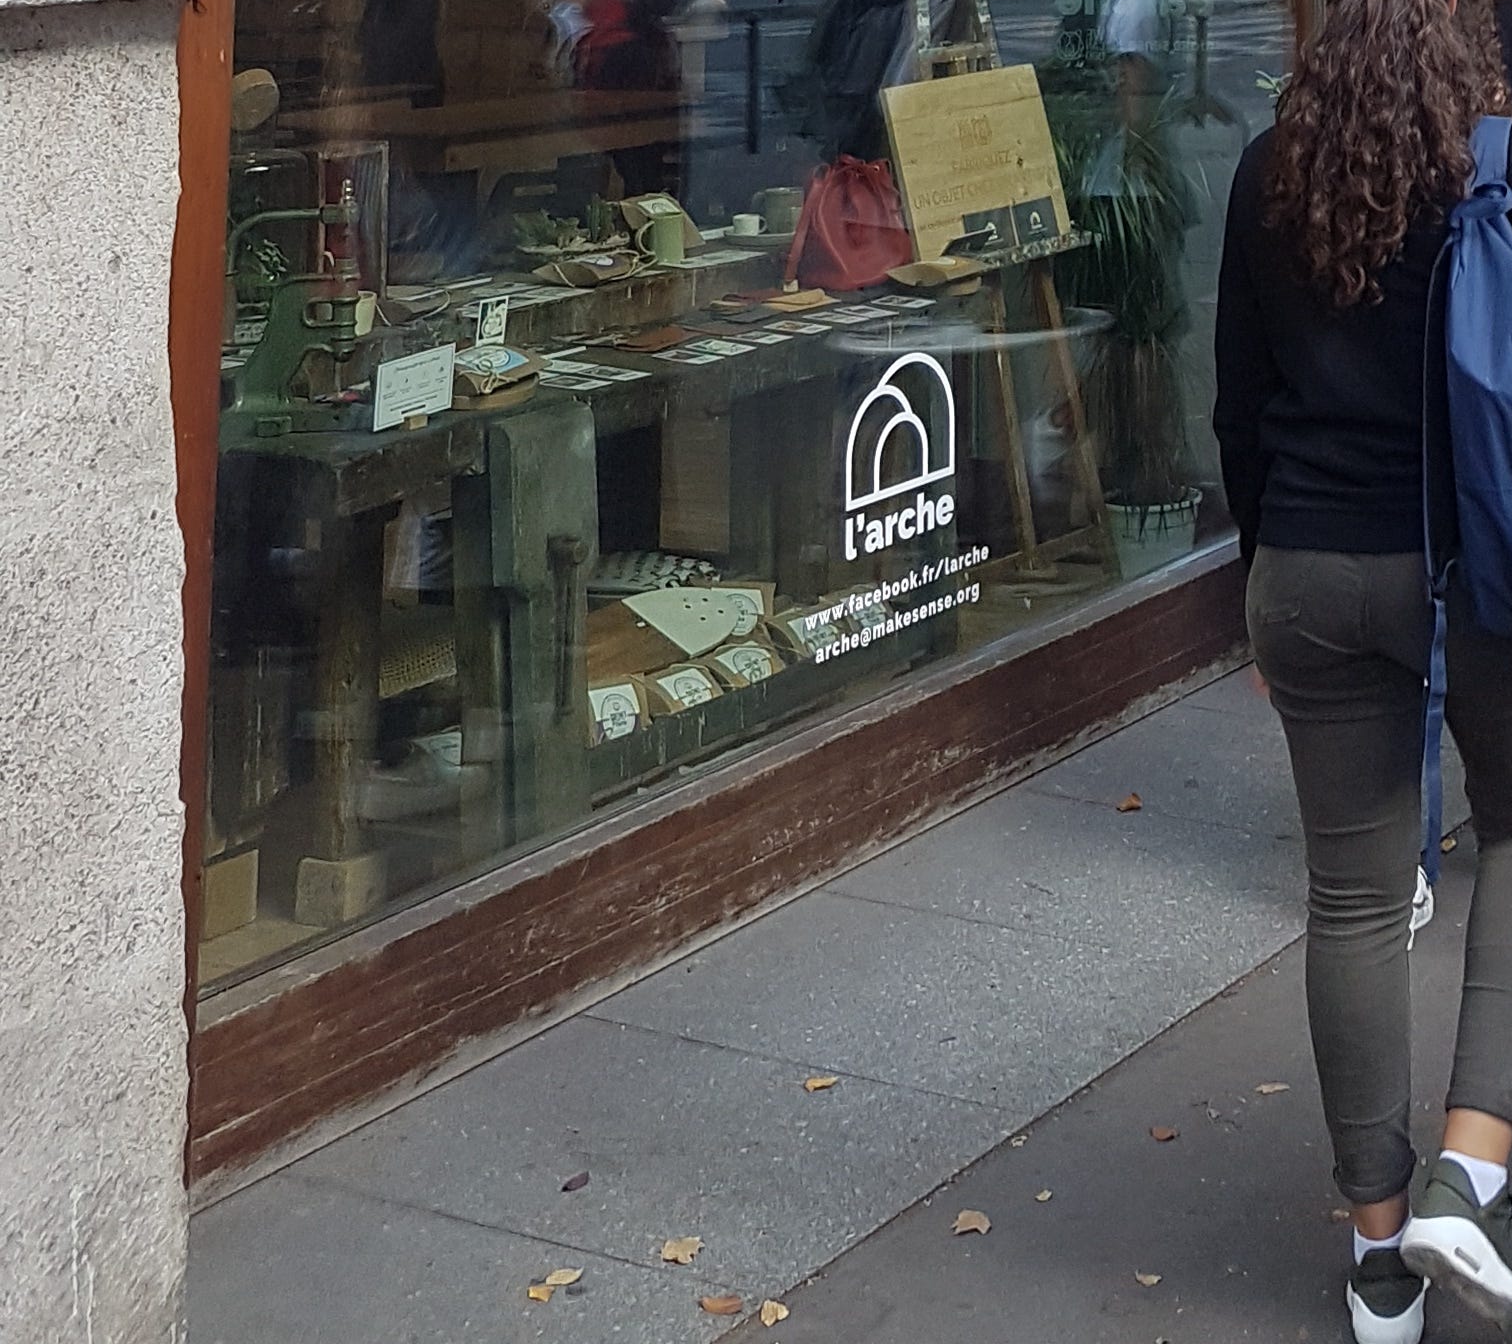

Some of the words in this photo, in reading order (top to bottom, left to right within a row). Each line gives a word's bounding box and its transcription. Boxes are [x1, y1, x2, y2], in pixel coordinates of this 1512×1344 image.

[913, 192, 931, 210] UN
[932, 185, 966, 207] OBJET
[844, 493, 956, 562] l'arche
[804, 543, 990, 632] www.facebook.fr/larche
[814, 580, 981, 665] arche@makesense.org
